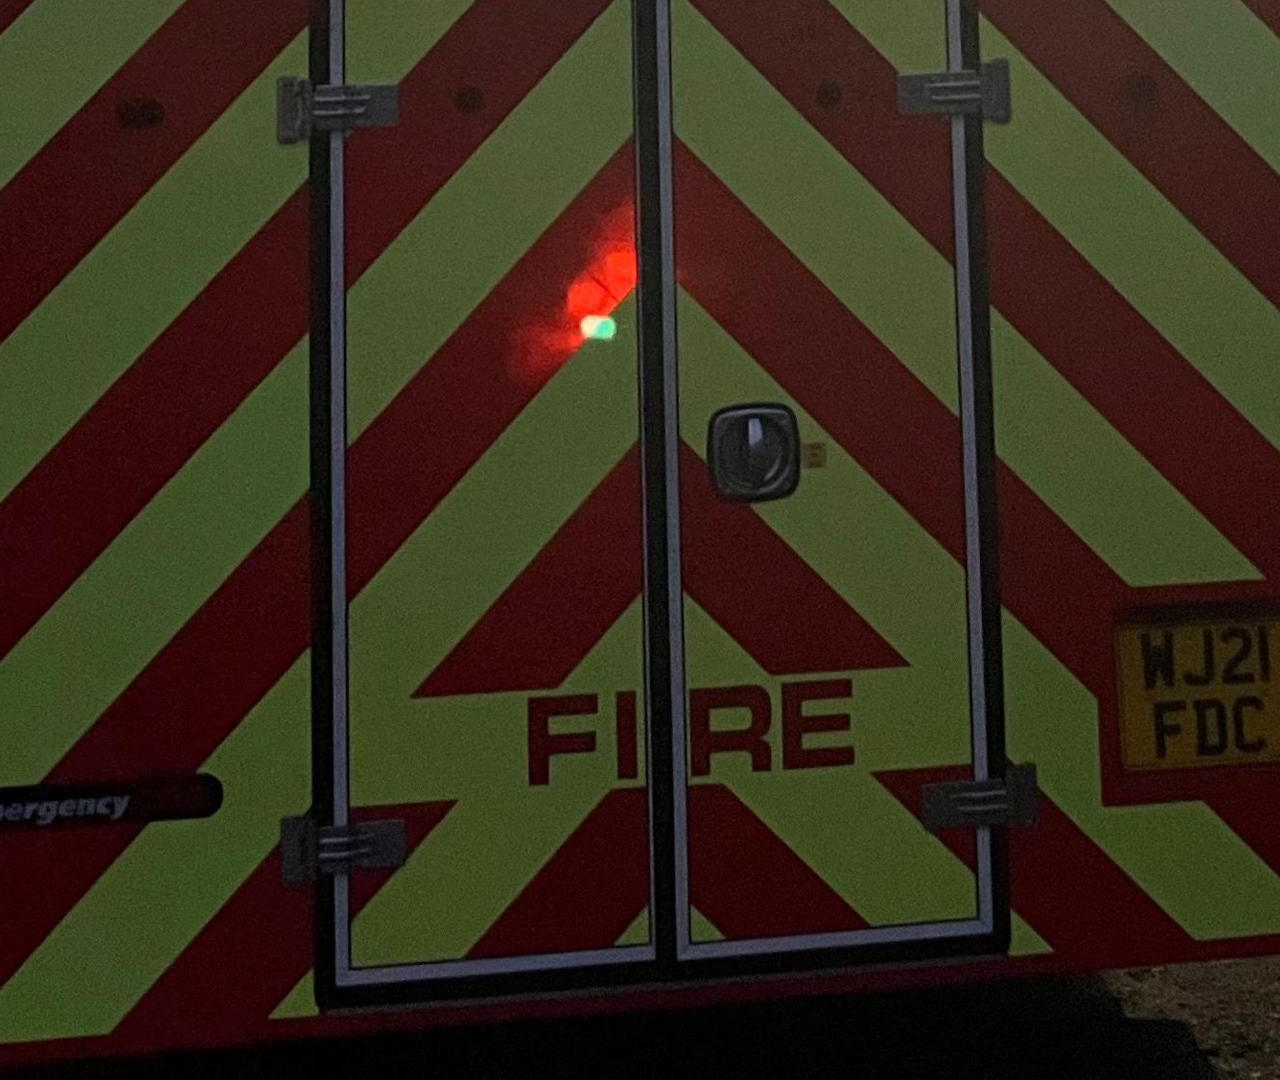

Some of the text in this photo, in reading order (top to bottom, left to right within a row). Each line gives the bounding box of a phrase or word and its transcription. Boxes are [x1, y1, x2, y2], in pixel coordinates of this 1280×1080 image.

[1140, 624, 1271, 691] WJ21
[527, 678, 855, 787] FIRE
[1153, 695, 1267, 759] FDC
